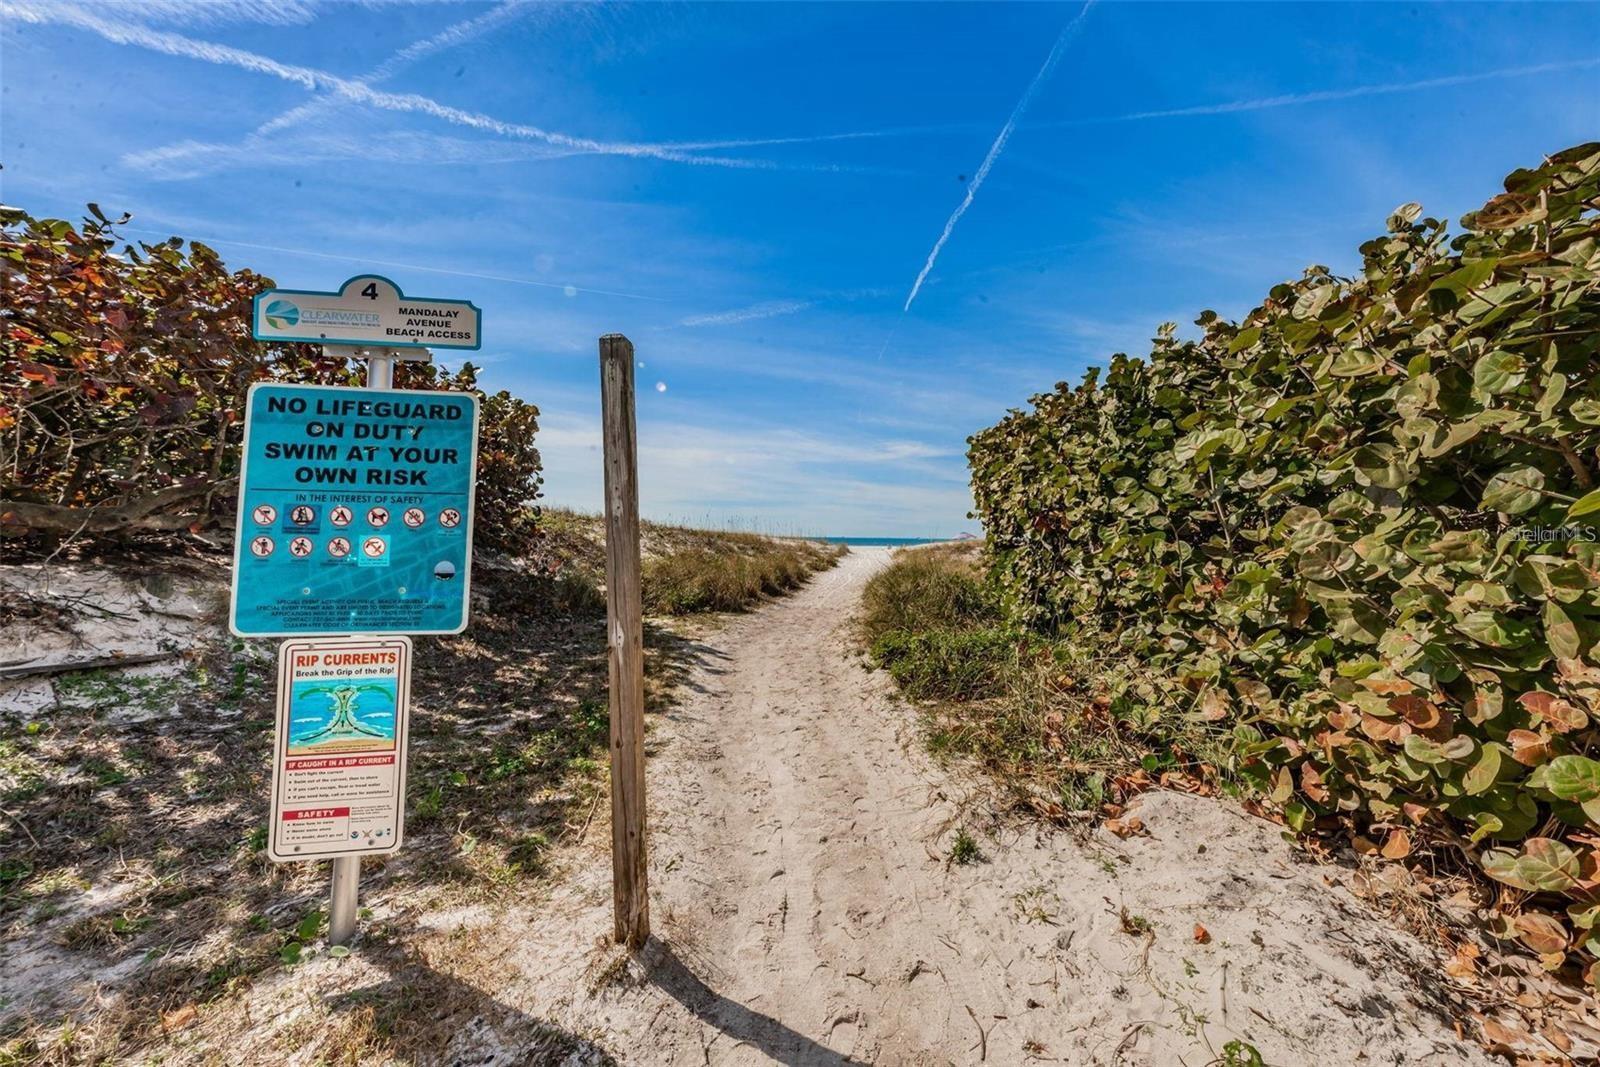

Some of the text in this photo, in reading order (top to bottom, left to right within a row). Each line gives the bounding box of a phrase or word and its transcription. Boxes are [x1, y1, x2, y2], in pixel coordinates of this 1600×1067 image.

[361, 282, 378, 300] 4
[301, 310, 380, 322] CLEARWATER
[398, 307, 460, 318] MANDALAY
[406, 318, 452, 328] AVENUE
[386, 328, 472, 340] BEACH ACCESS
[268, 396, 462, 420] NO LIFEGUARD
[306, 421, 424, 441] ON DUTY
[265, 442, 458, 464] SWIM AT YOUR
[295, 466, 428, 486] OWN RISK
[310, 494, 326, 502] THE
[330, 495, 371, 503] INTEREST
[374, 496, 387, 504] OF
[390, 496, 424, 504] SAFETY
[296, 652, 396, 667] RIP CURRENTS
[336, 668, 352, 677] Grip
[380, 667, 395, 675] Rip!
[298, 810, 335, 819] SAFETY
